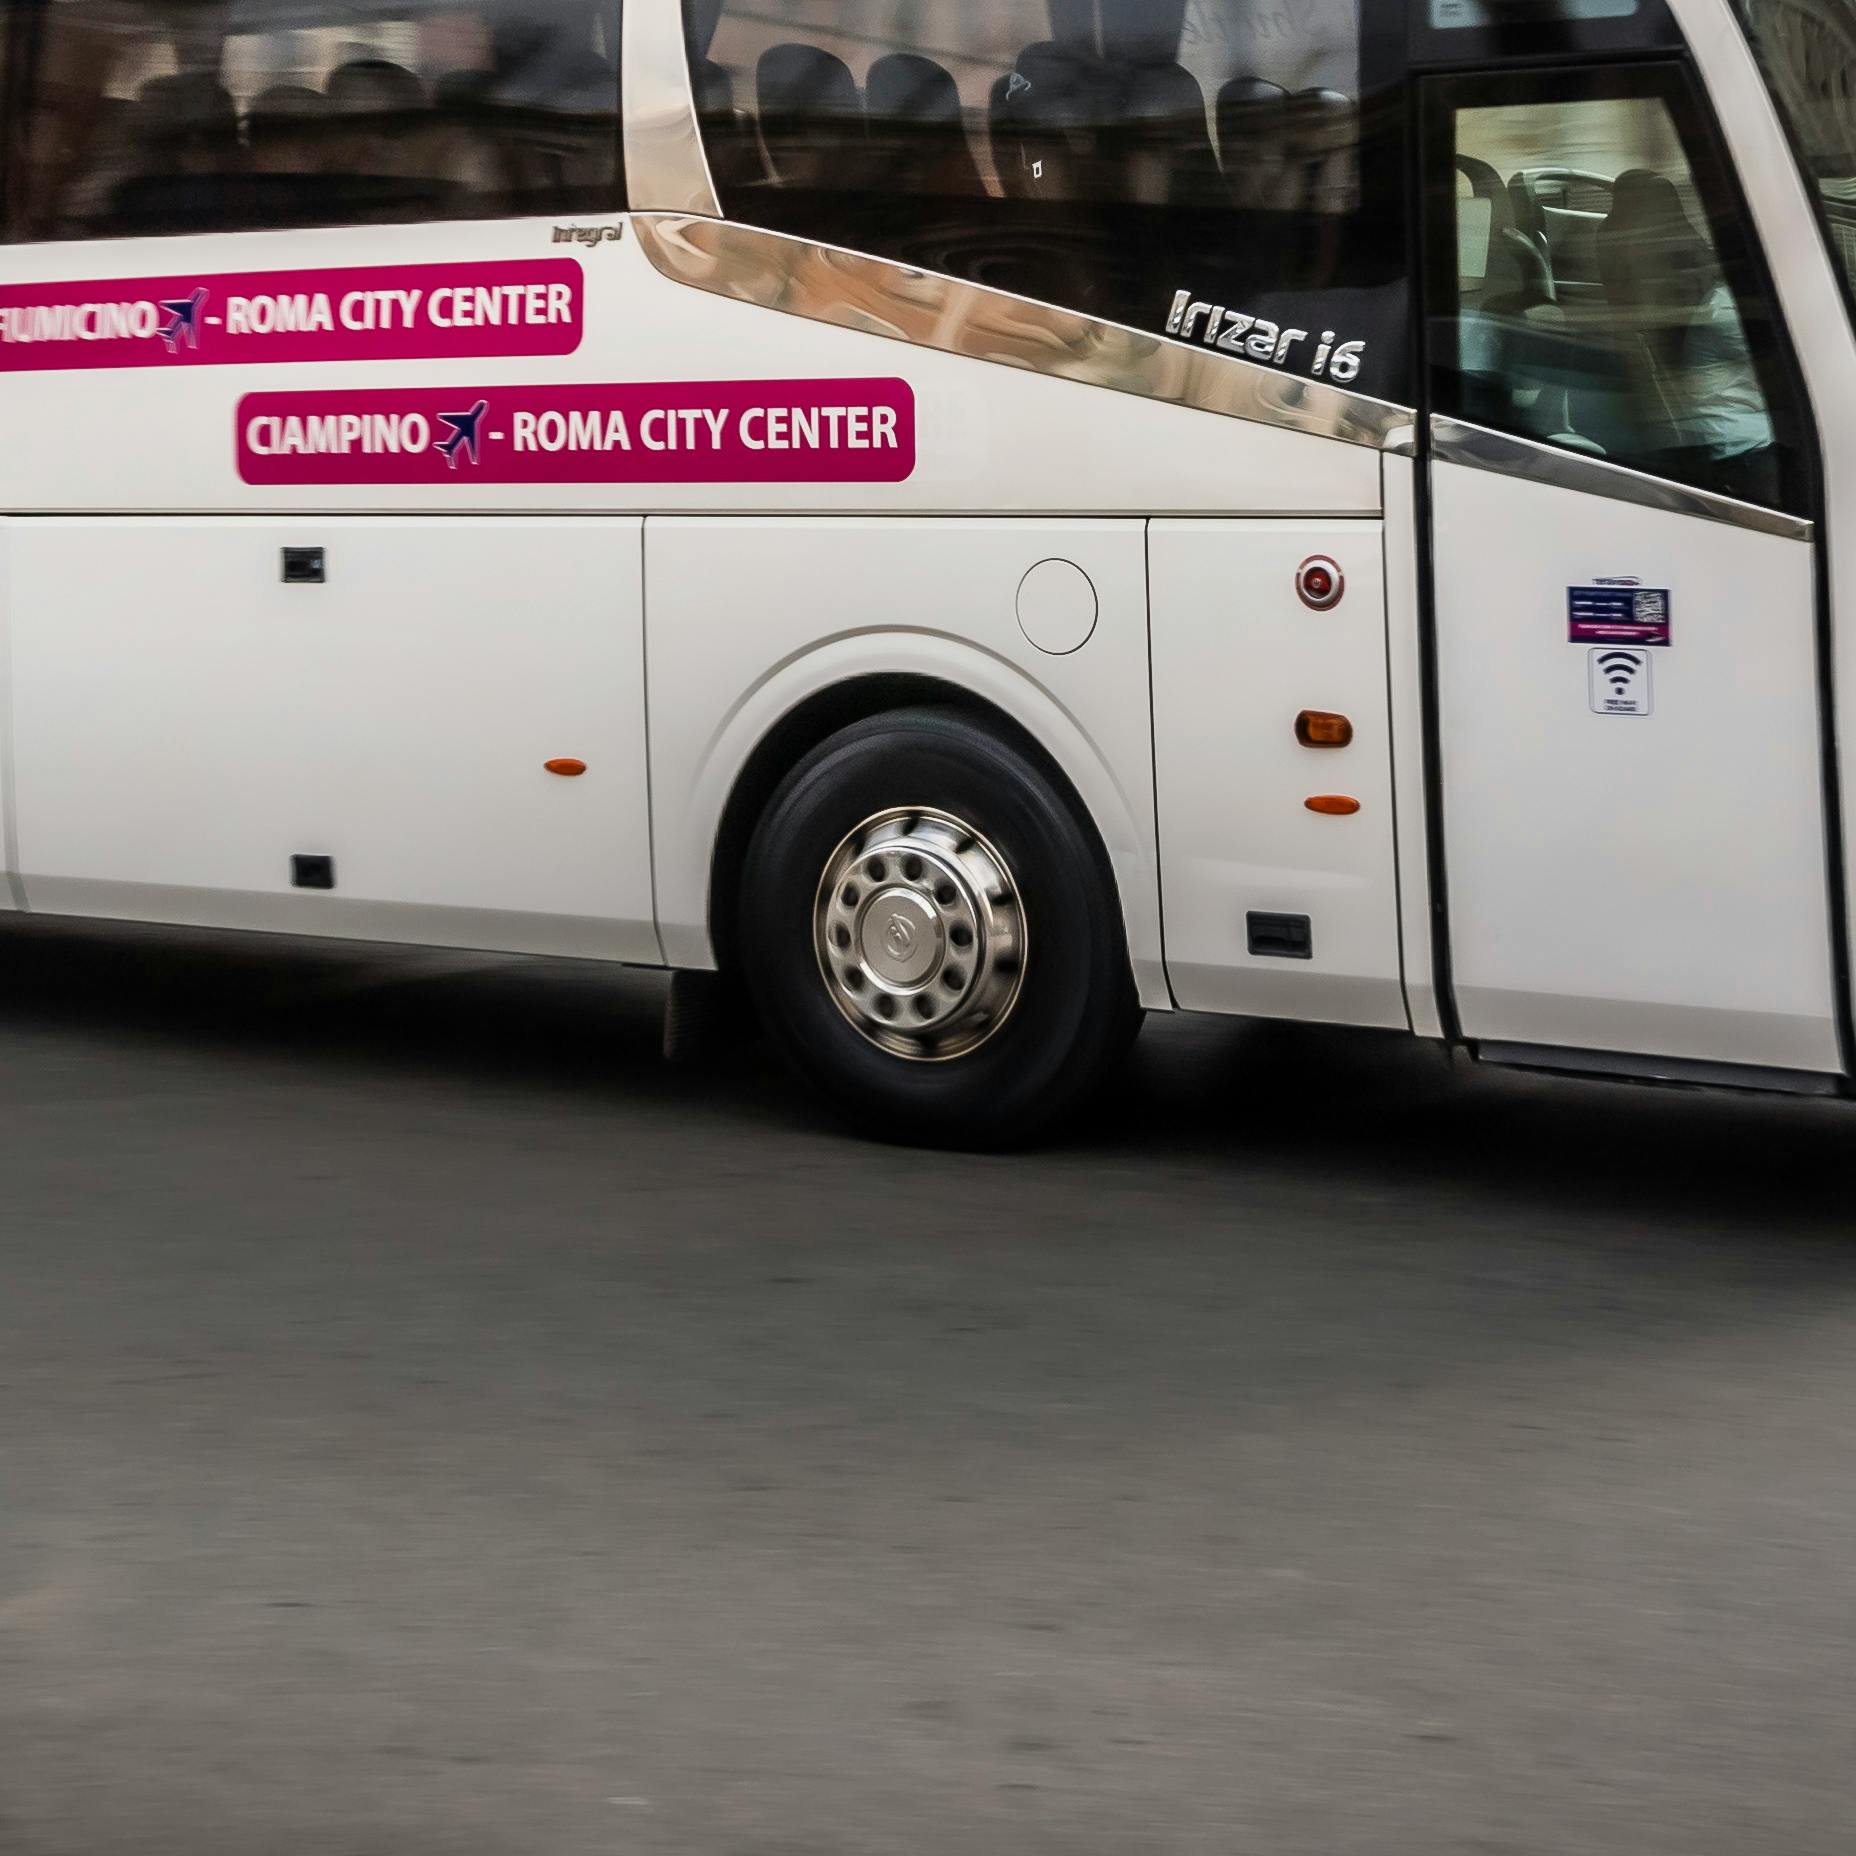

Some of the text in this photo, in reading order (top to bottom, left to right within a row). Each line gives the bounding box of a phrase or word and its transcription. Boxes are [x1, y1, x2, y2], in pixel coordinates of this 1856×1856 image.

[226, 293, 334, 335] ROMA
[340, 289, 423, 332] CITY
[427, 282, 574, 328] CENTER
[1165, 289, 1366, 384] Irizar i6
[246, 411, 430, 455] CIAMPINO
[512, 409, 631, 451] ROMA
[639, 407, 729, 450] CITY
[738, 406, 900, 449] CENTER
